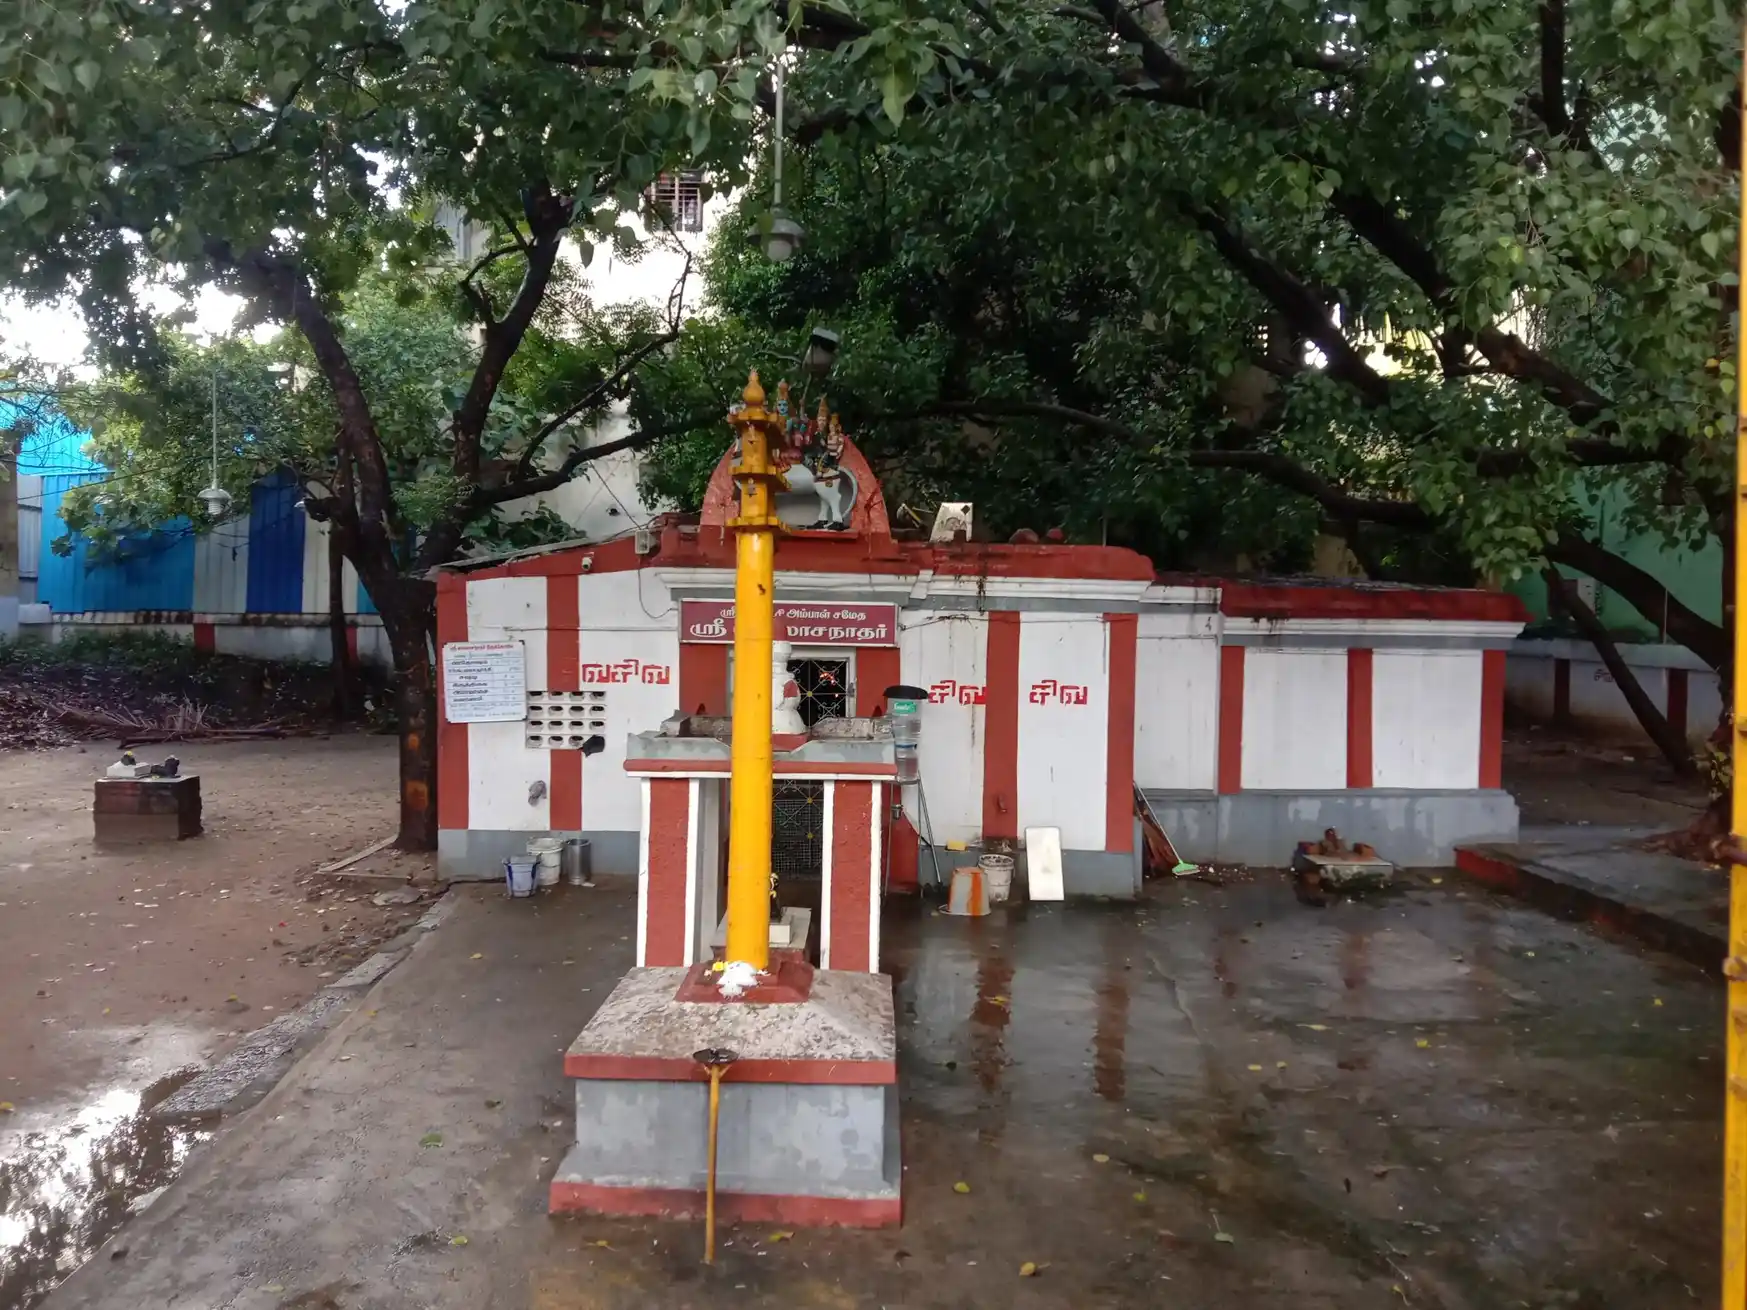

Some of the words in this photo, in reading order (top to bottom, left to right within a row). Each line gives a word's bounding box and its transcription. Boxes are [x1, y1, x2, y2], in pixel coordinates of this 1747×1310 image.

[787, 608, 830, 619] அம்பாள்
[833, 609, 867, 621] சமேத
[690, 618, 727, 637] ஸ்ரீ
[1029, 680, 1088, 705] சிவ
